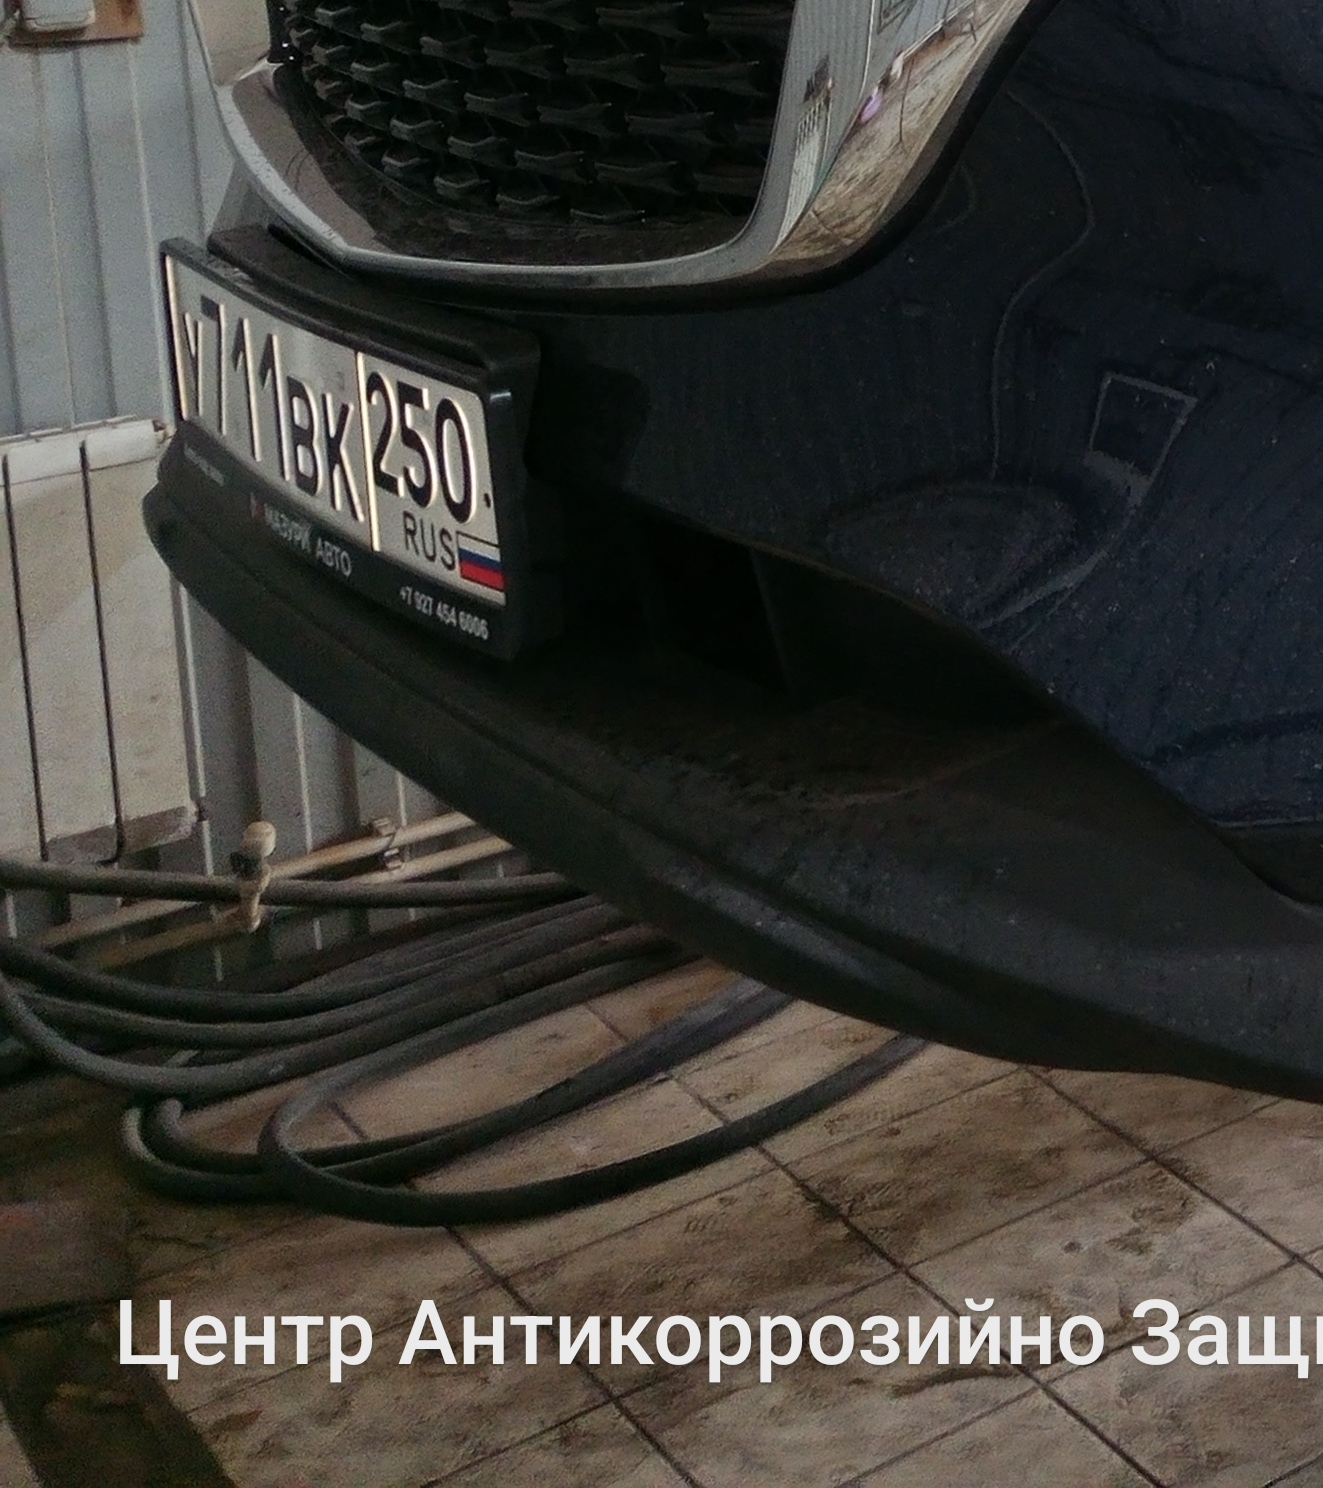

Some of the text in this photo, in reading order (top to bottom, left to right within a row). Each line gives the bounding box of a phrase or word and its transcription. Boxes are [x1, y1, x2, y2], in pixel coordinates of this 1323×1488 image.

[366, 371, 477, 524] 250
[315, 536, 352, 578] АВТО
[403, 510, 457, 572] RUS
[436, 600, 457, 627] 454
